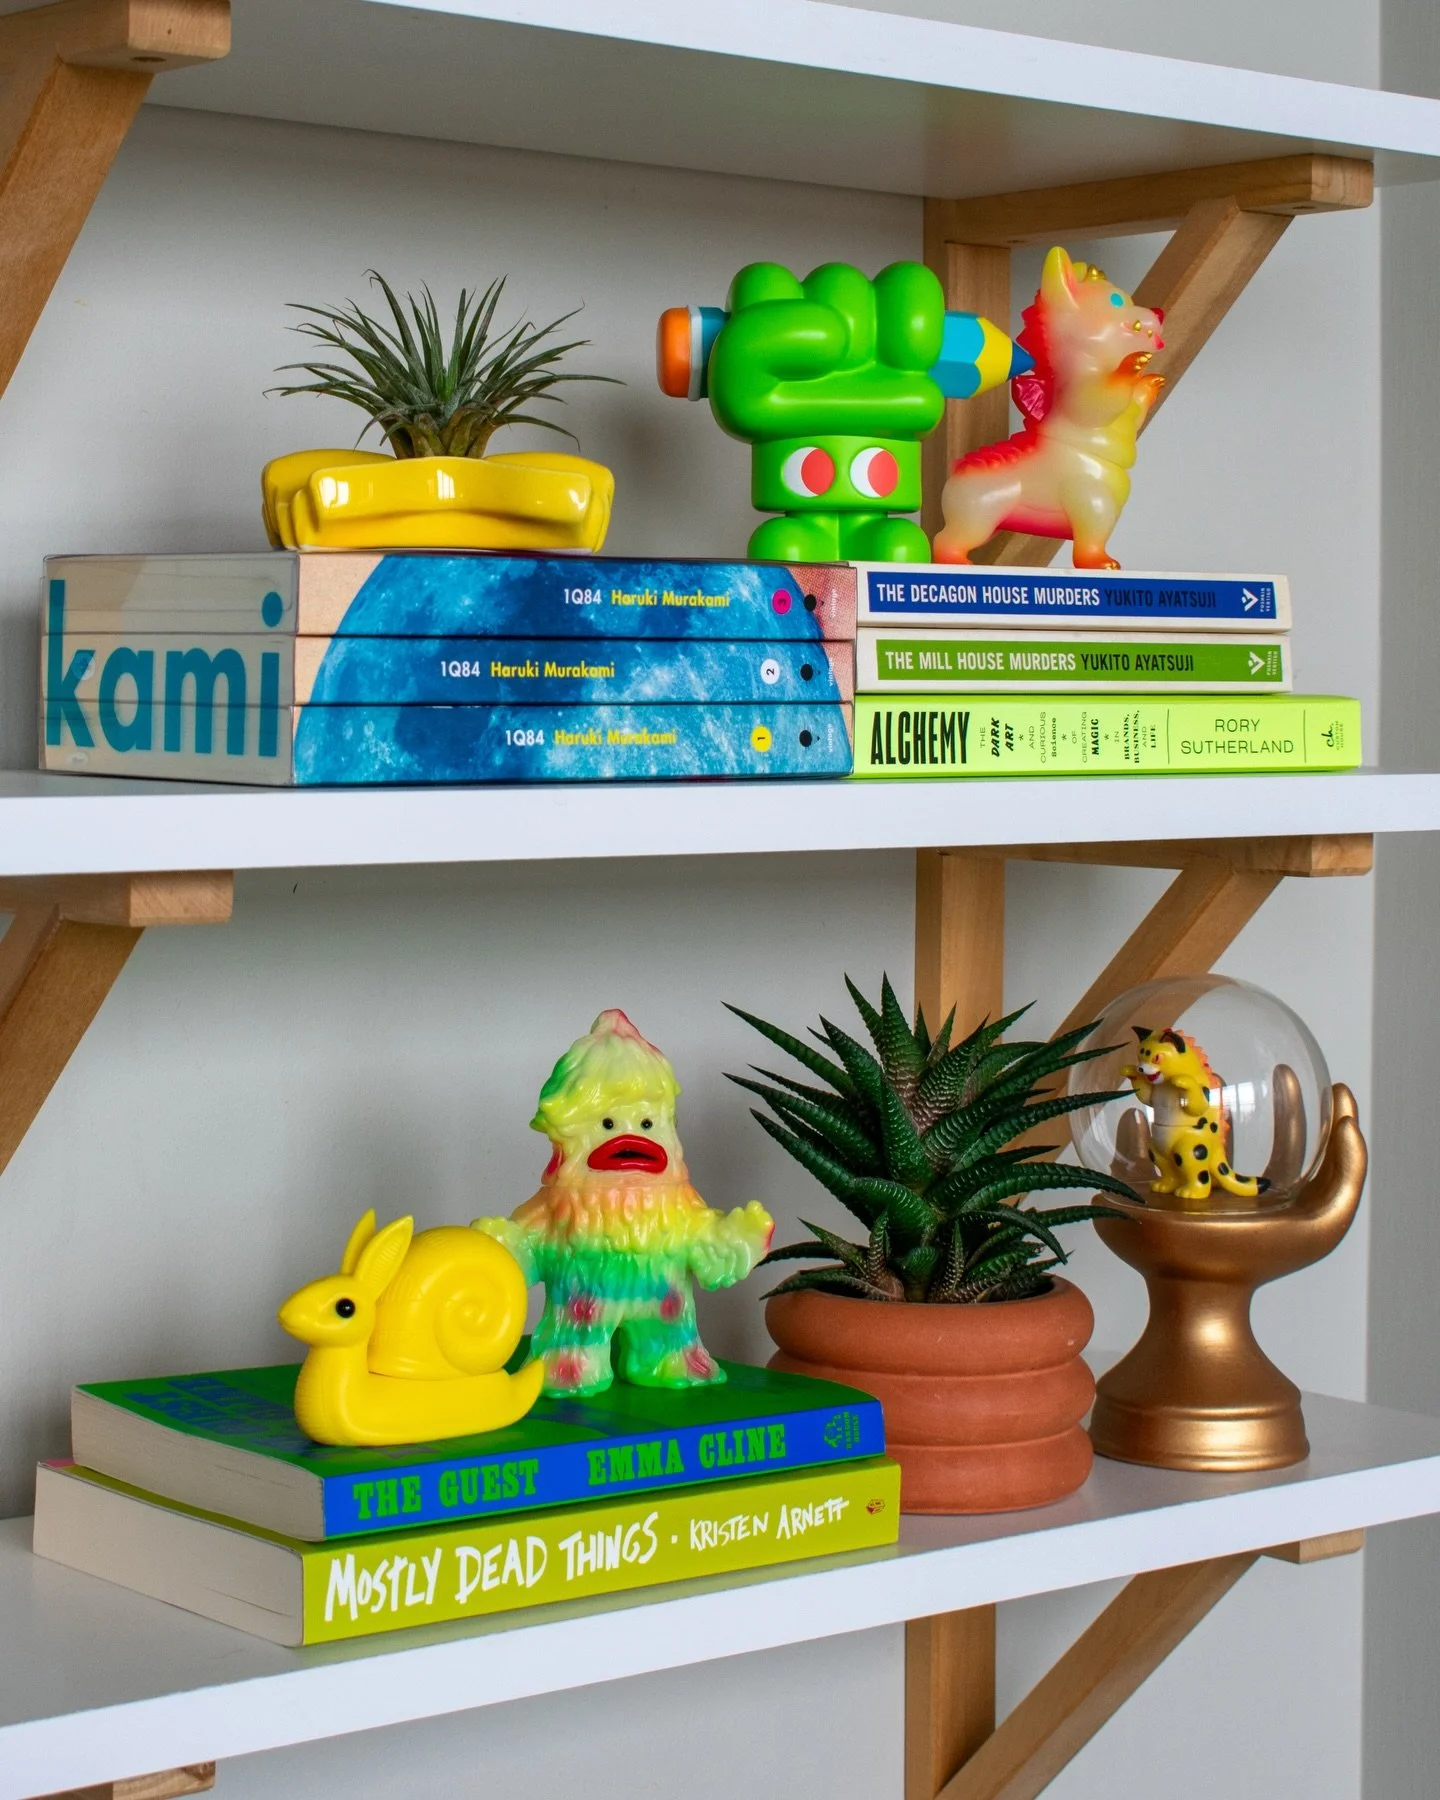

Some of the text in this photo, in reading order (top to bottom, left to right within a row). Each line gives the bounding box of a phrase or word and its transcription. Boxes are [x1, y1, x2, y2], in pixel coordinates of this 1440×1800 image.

[564, 588, 730, 607] 1Q84 Haruki Murakami
[830, 588, 838, 618] vintage
[876, 583, 1216, 608] THE DECAGON HOUSE MURDERS YUKITO AYATSUJI
[46, 579, 283, 757] kami
[440, 660, 615, 678] 1Q84 Haruki Murakami
[766, 668, 775, 676] 2
[885, 651, 1194, 671] THE MILL HOUSE MURDERS YUKITO AYATSUJI
[505, 726, 677, 746] 1Q84 Haruki Murakami
[827, 723, 835, 753] vintage
[870, 711, 970, 765] ALCHEMY
[990, 717, 1000, 757] DARK
[1005, 723, 1014, 752] ART
[1072, 730, 1078, 744] OF
[1090, 718, 1099, 755] MAGIC
[1114, 731, 1120, 742] IN
[1215, 719, 1260, 732] RORY
[1181, 740, 1294, 754] SUTHERLAND
[352, 1424, 786, 1520] THE GUEST EMMA CLINE
[324, 1497, 849, 1622] MOSTLY DEAD THINGS KRISTEN ARNETT
